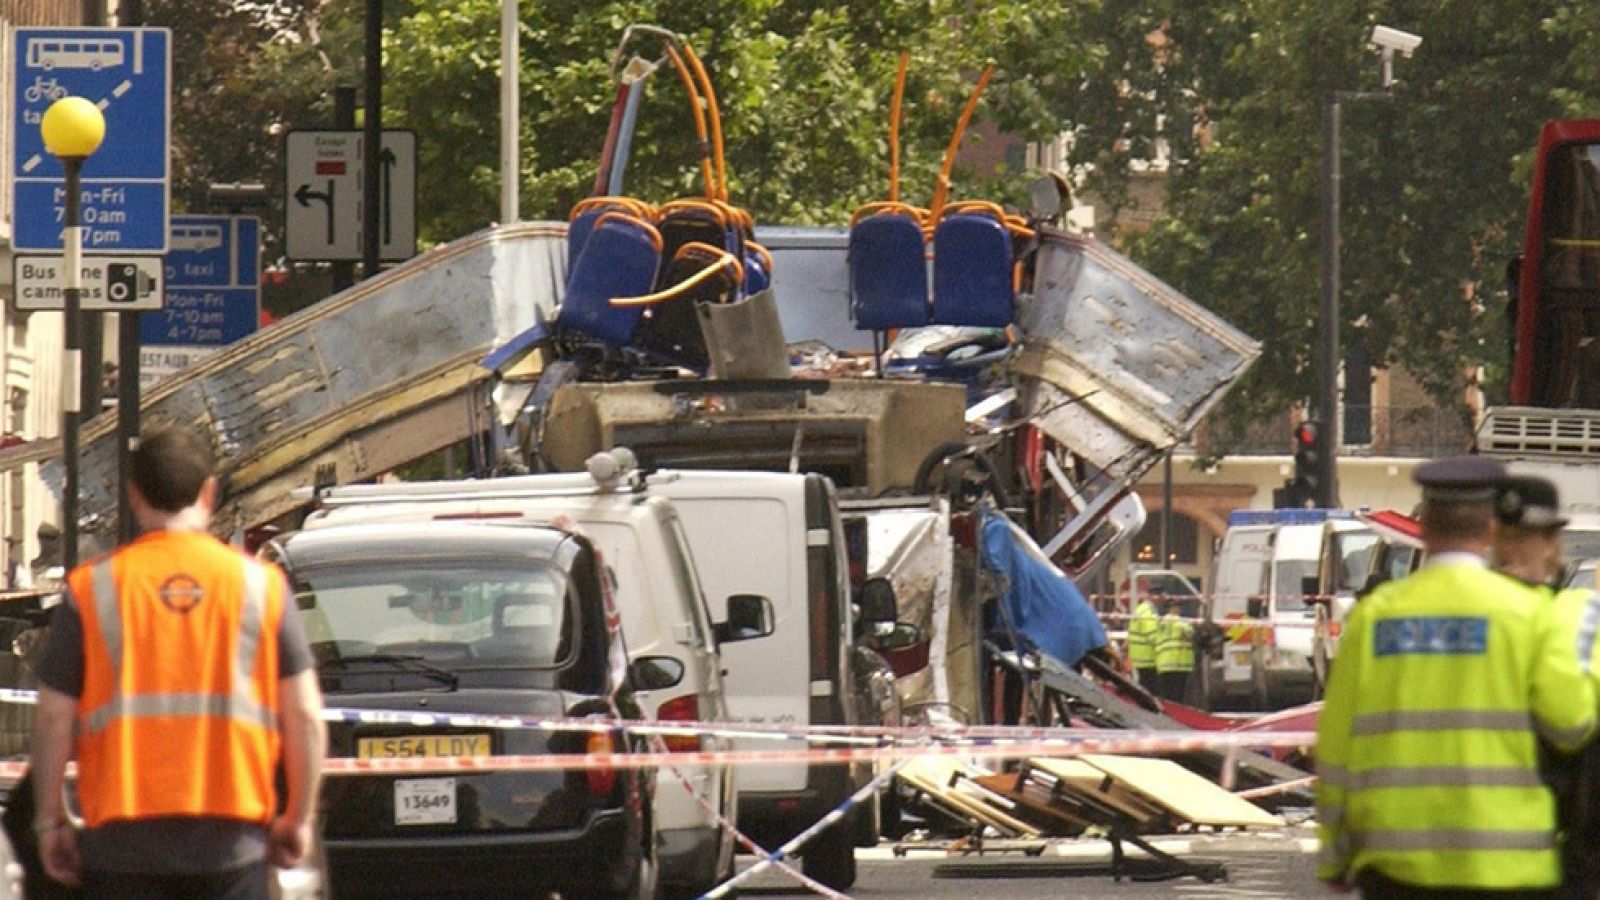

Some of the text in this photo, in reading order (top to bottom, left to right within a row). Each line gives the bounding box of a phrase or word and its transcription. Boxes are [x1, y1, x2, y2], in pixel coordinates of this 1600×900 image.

[53, 187, 125, 203] Mn-Fri
[54, 207, 125, 223] 70am
[22, 264, 56, 279] Bus
[185, 263, 214, 276] taxi
[22, 287, 102, 298] camas
[164, 293, 224, 306] Mon-Fri
[167, 326, 222, 340] 4-7pm
[1375, 618, 1486, 653] POLICE
[434, 738, 478, 757] LDY
[403, 794, 450, 809] 13649
